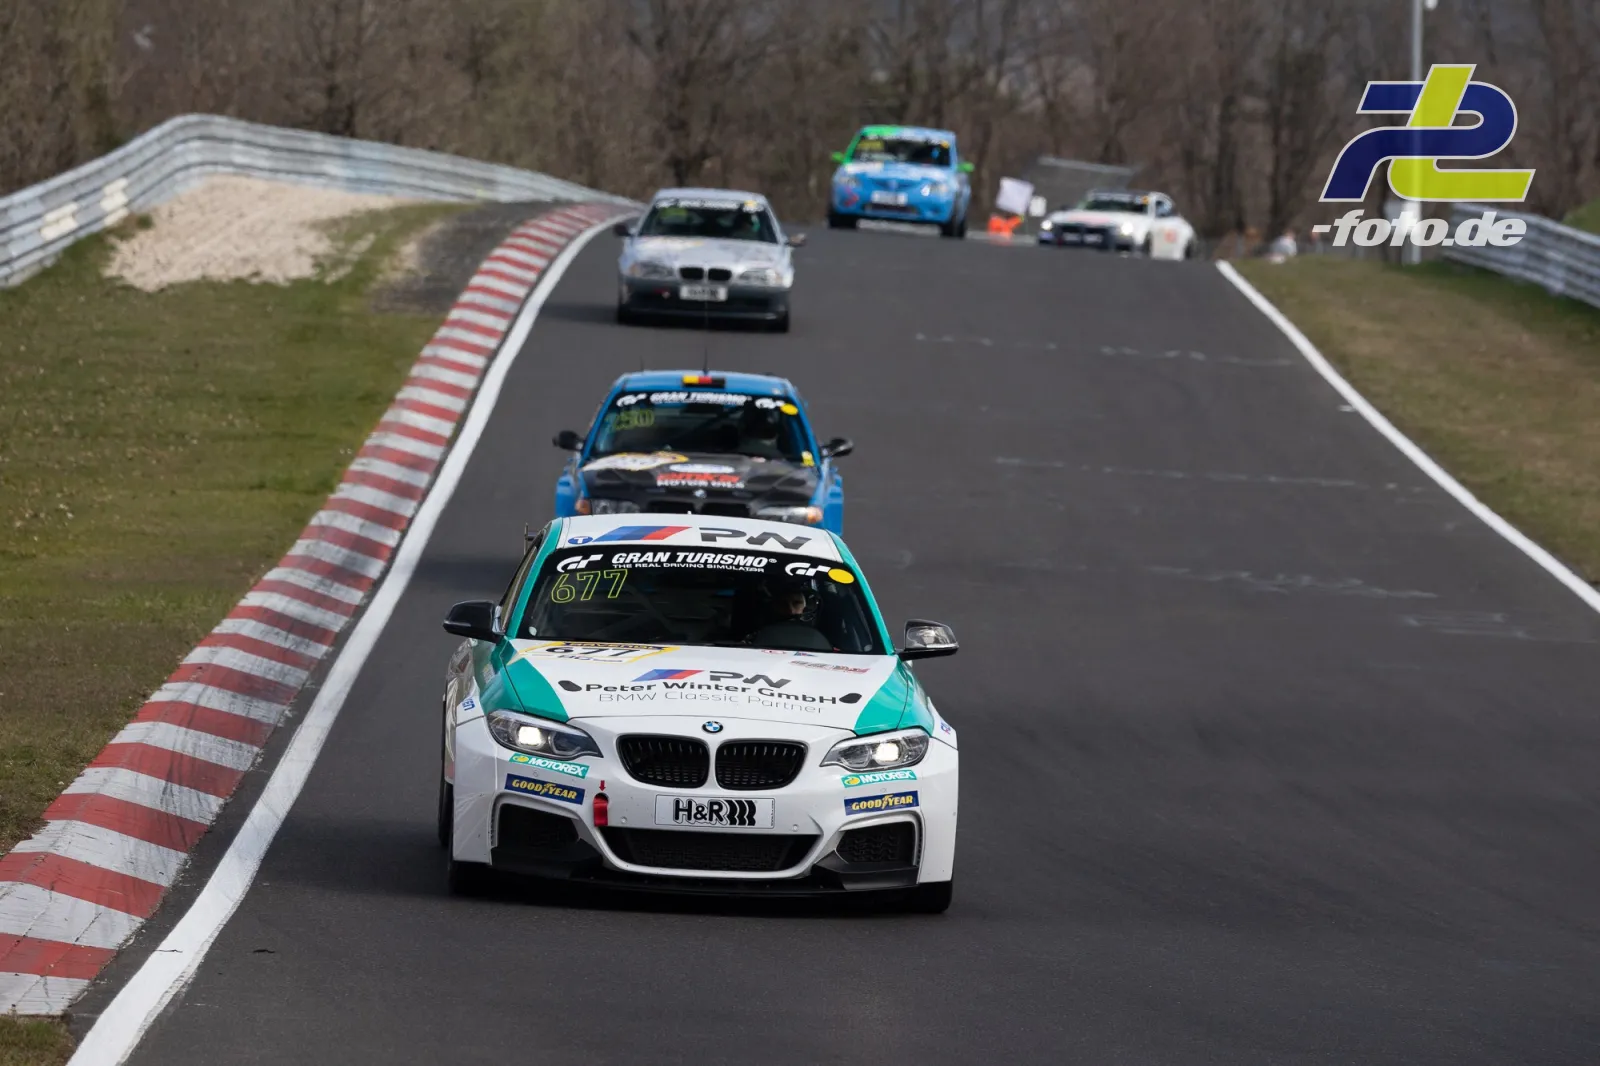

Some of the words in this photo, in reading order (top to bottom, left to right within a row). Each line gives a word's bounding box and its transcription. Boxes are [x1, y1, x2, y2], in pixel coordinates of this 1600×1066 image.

[611, 552, 669, 564] GRAN
[706, 563, 765, 573] SIMULATOR
[551, 568, 628, 603] 677
[546, 646, 641, 657] 677
[585, 681, 657, 692] Peter
[662, 681, 752, 692] Winter
[757, 688, 837, 705] GmbH
[599, 692, 657, 702] BMW
[664, 691, 738, 702] Classic
[748, 695, 825, 714] Partner
[528, 757, 585, 776] MOTOREX
[859, 770, 915, 784] MOTOREX
[511, 779, 578, 800] GOODYEAR
[673, 799, 726, 823] H&R
[851, 794, 913, 811] GOODYEAR
